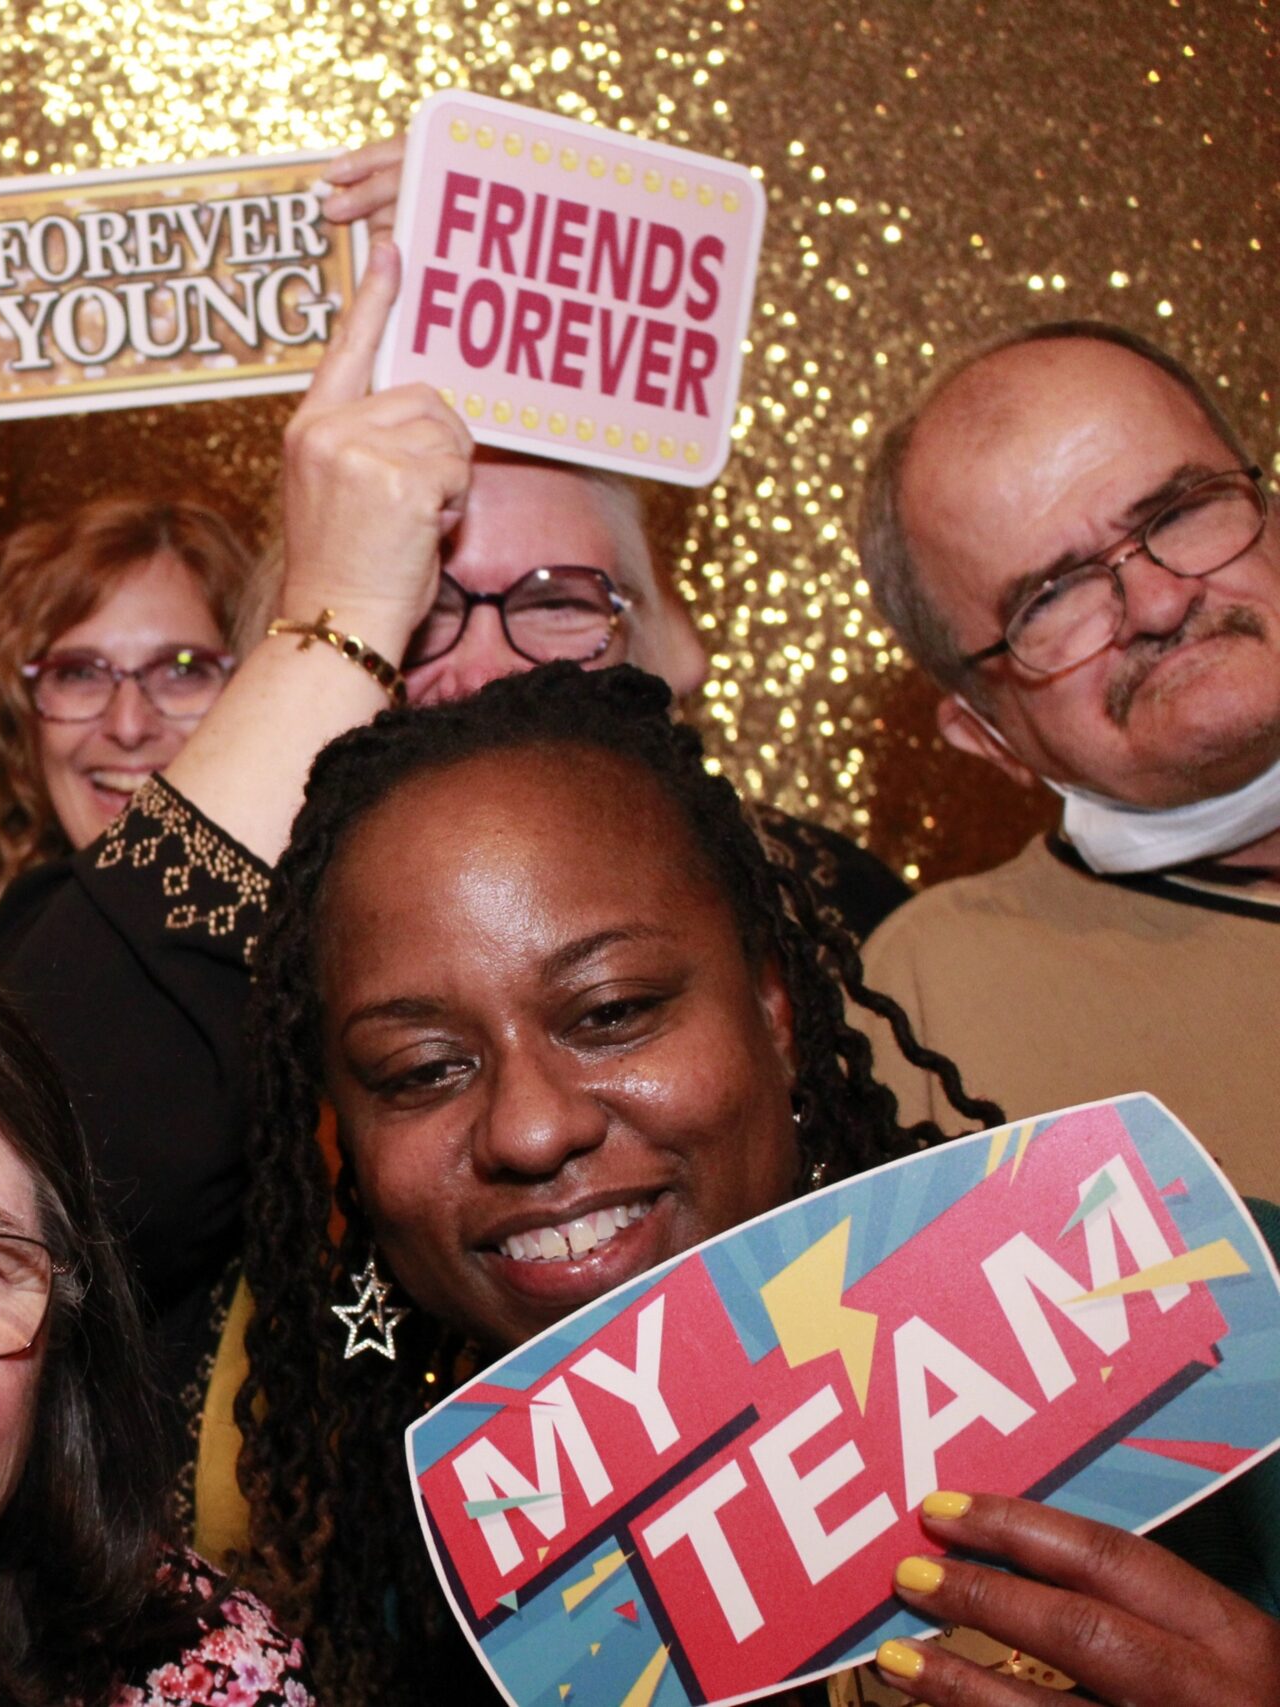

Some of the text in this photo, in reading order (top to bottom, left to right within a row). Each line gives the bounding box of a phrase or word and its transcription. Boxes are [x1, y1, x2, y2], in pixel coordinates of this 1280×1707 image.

[412, 267, 718, 418] FOREVER
[434, 170, 726, 323] FRIENDS
[451, 1293, 680, 1577] MY
[641, 1153, 1190, 1645] TEAM
